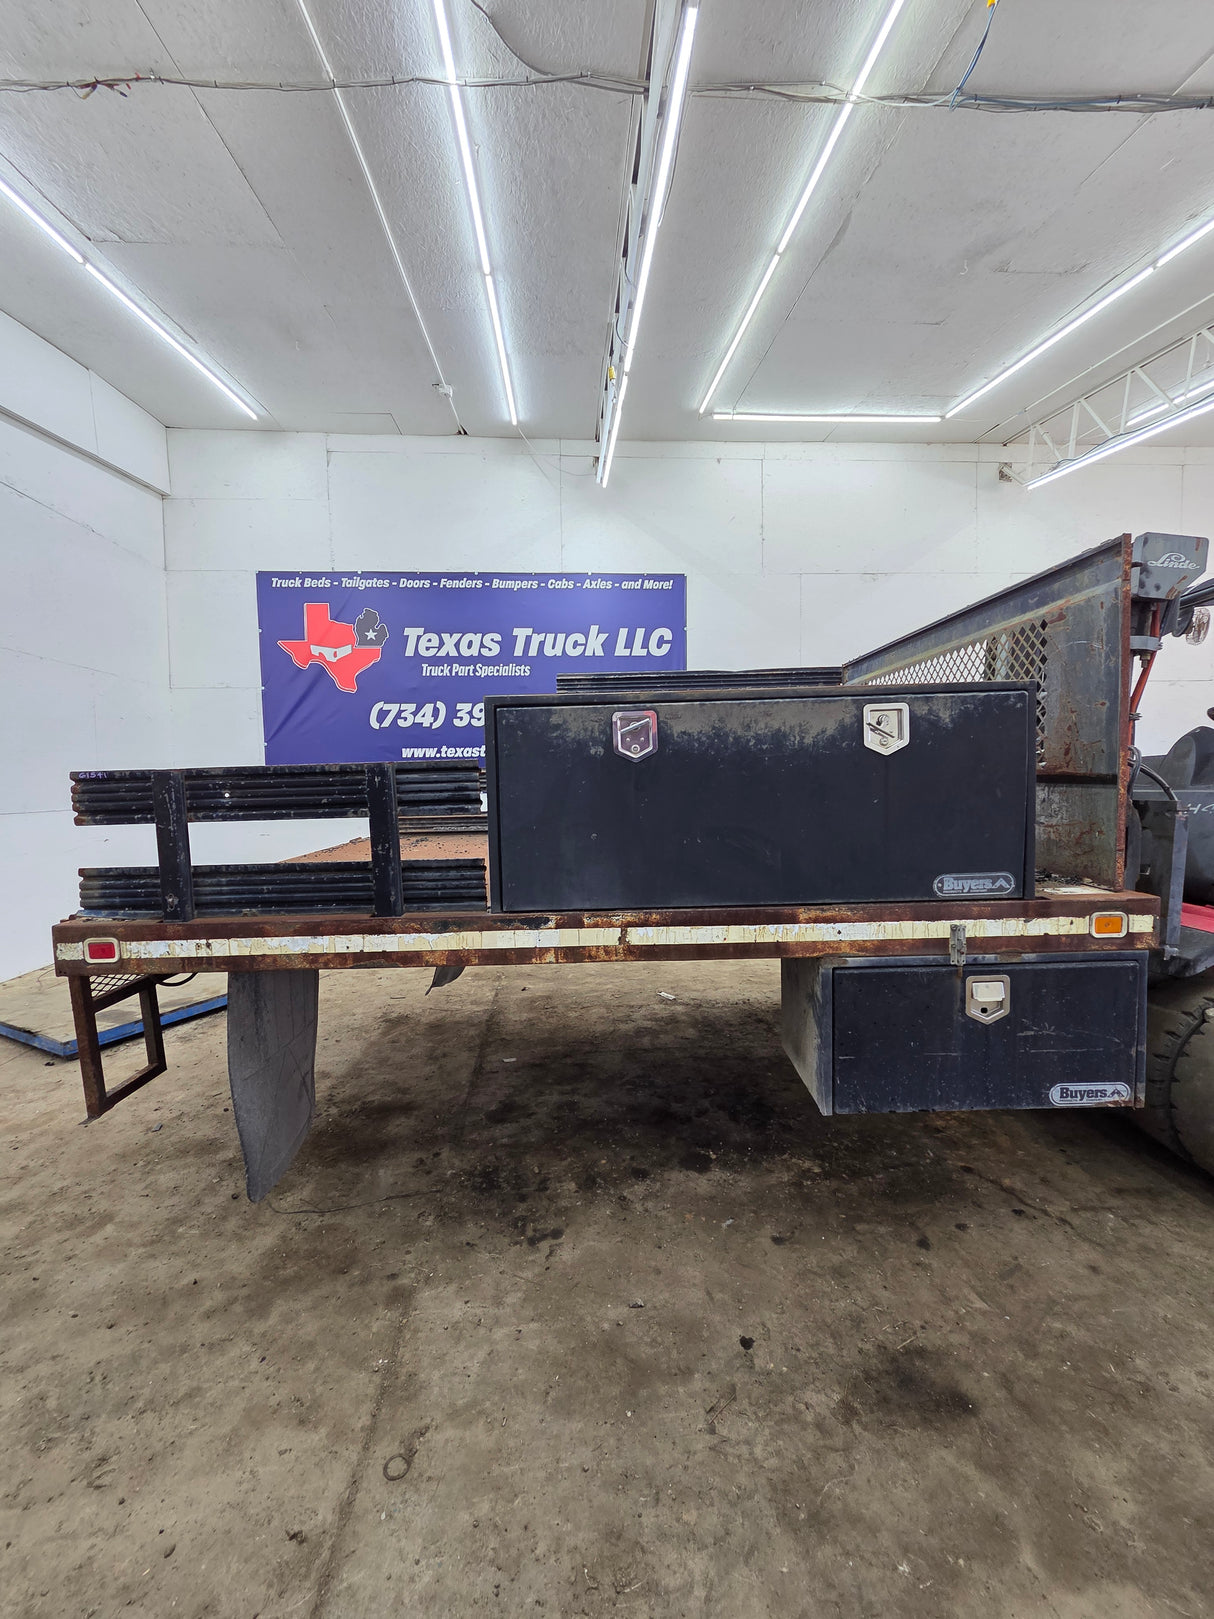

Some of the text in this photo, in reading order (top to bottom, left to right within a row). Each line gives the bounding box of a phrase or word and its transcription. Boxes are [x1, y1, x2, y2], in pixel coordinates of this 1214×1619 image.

[1148, 552, 1200, 569] Linde
[271, 577, 302, 588] Truck
[303, 577, 331, 588] Beds
[341, 577, 390, 590] Tailgates
[399, 578, 431, 588] Doors
[440, 578, 483, 589] Fenders
[492, 579, 539, 591] Bumpers
[547, 578, 575, 589] Cabs
[583, 579, 613, 589] Axles
[621, 579, 641, 589] and
[642, 580, 673, 590] More!
[403, 625, 673, 657] Texas Truck LLC
[422, 663, 531, 678] Truck Part Specialists
[369, 701, 485, 730] (734) 39
[401, 745, 486, 758] www.texast
[943, 877, 993, 893] Buyers
[1059, 1087, 1108, 1101] Buyers
